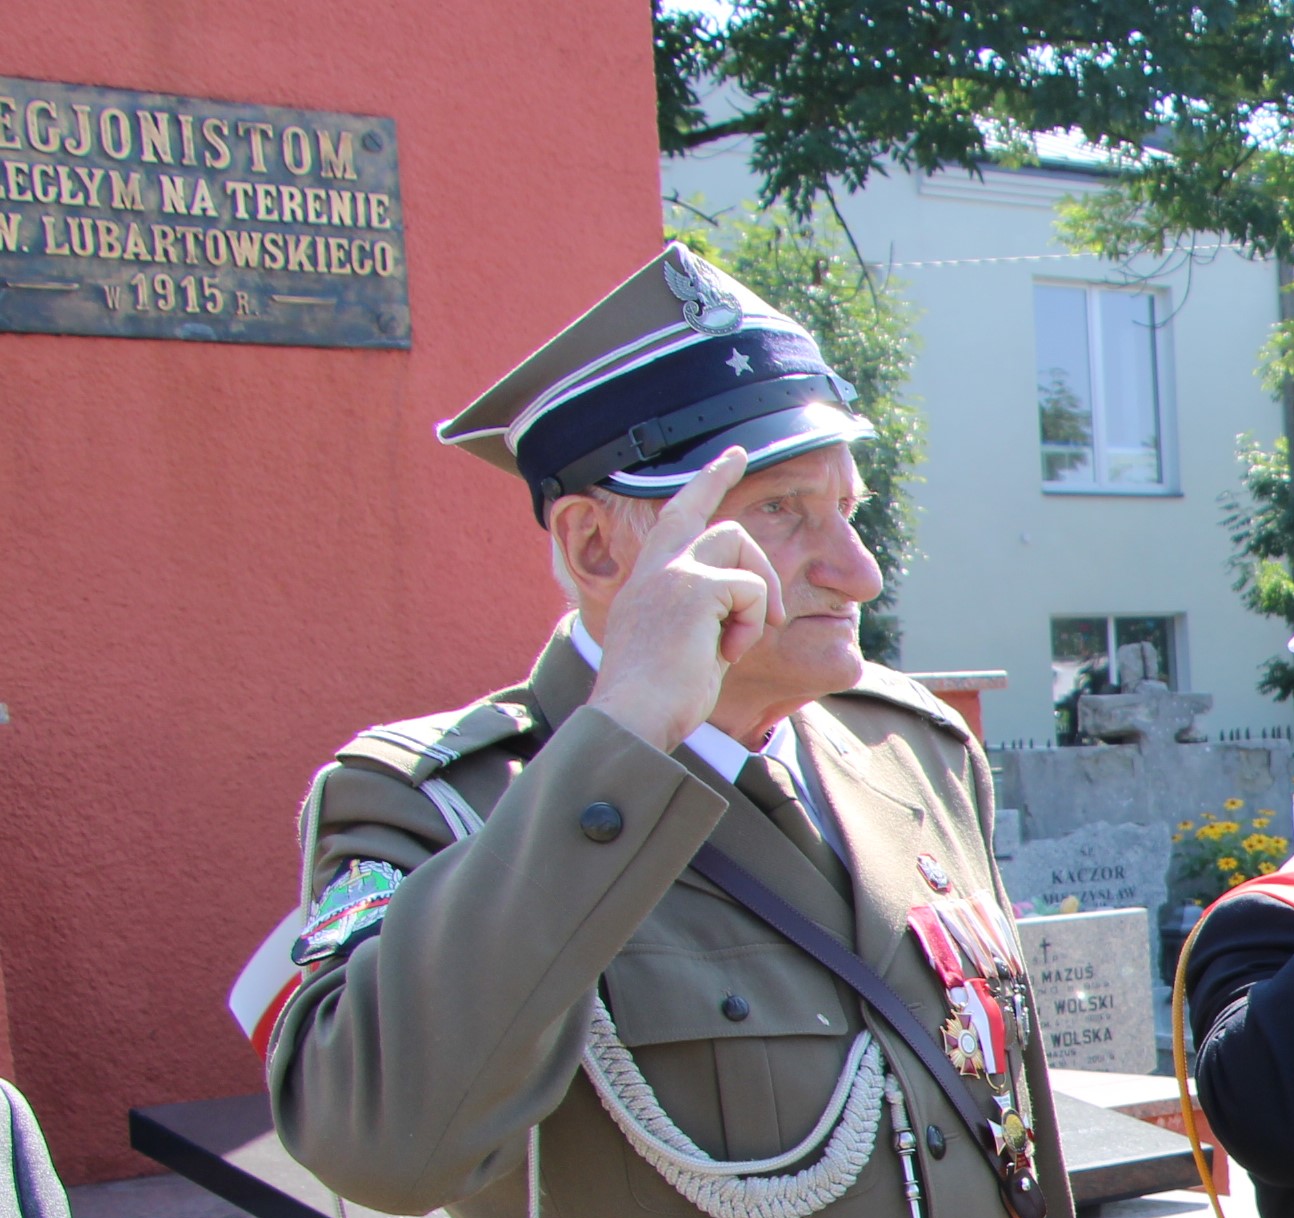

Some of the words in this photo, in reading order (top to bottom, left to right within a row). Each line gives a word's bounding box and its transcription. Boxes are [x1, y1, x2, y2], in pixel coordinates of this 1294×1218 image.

[0, 160, 145, 211] EGŁYM
[160, 175, 218, 217] NA
[225, 181, 391, 230] TERENIE
[42, 216, 393, 276] LUBARTOWSKIEGO
[131, 272, 224, 313] 1915
[1051, 865, 1125, 885] KACZOR
[1042, 962, 1094, 983] MAZUŚ
[1054, 994, 1114, 1015] WOLSKI
[1050, 1027, 1113, 1048] WOLSKA
